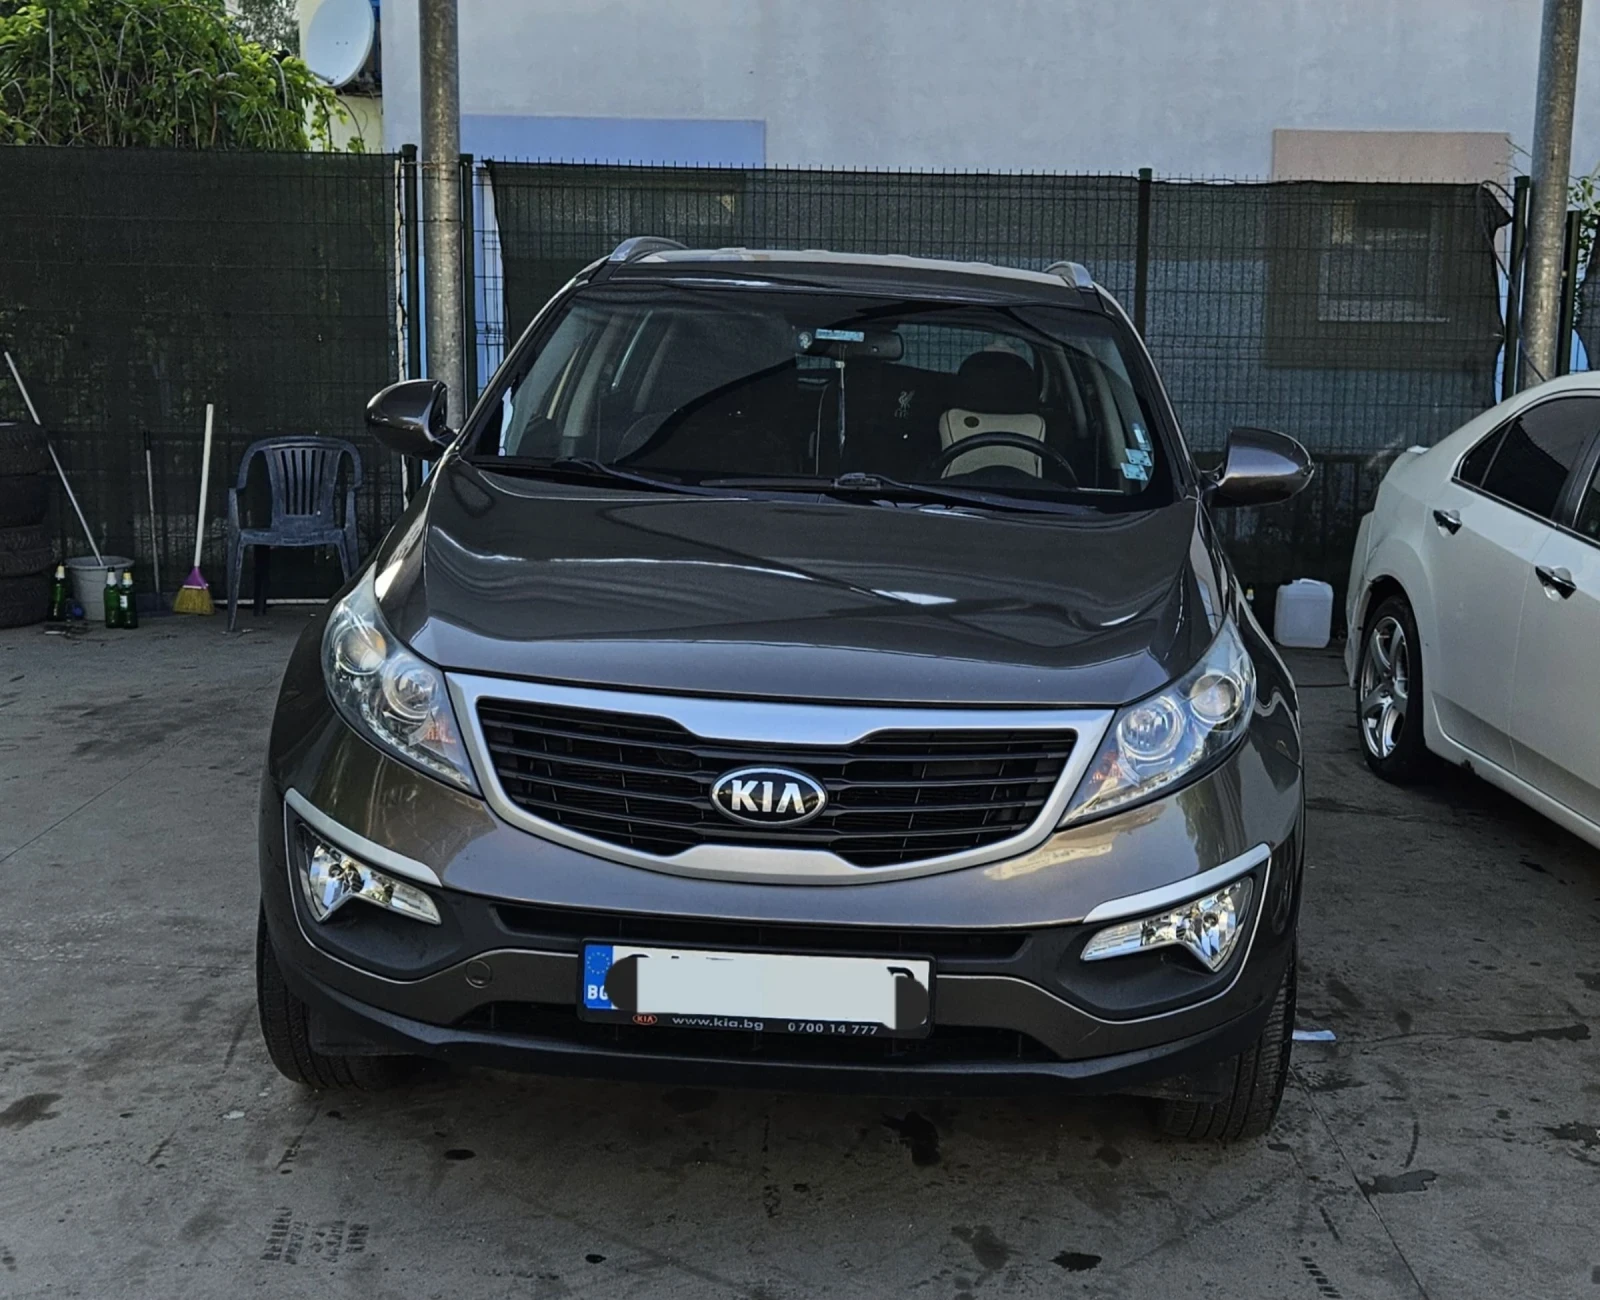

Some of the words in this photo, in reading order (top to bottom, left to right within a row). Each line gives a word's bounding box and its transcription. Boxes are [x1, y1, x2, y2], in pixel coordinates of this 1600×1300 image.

[731, 779, 806, 814] KIA
[671, 1017, 764, 1032] www.kia.bg
[829, 1023, 847, 1034] 14
[850, 1024, 879, 1036] 777
